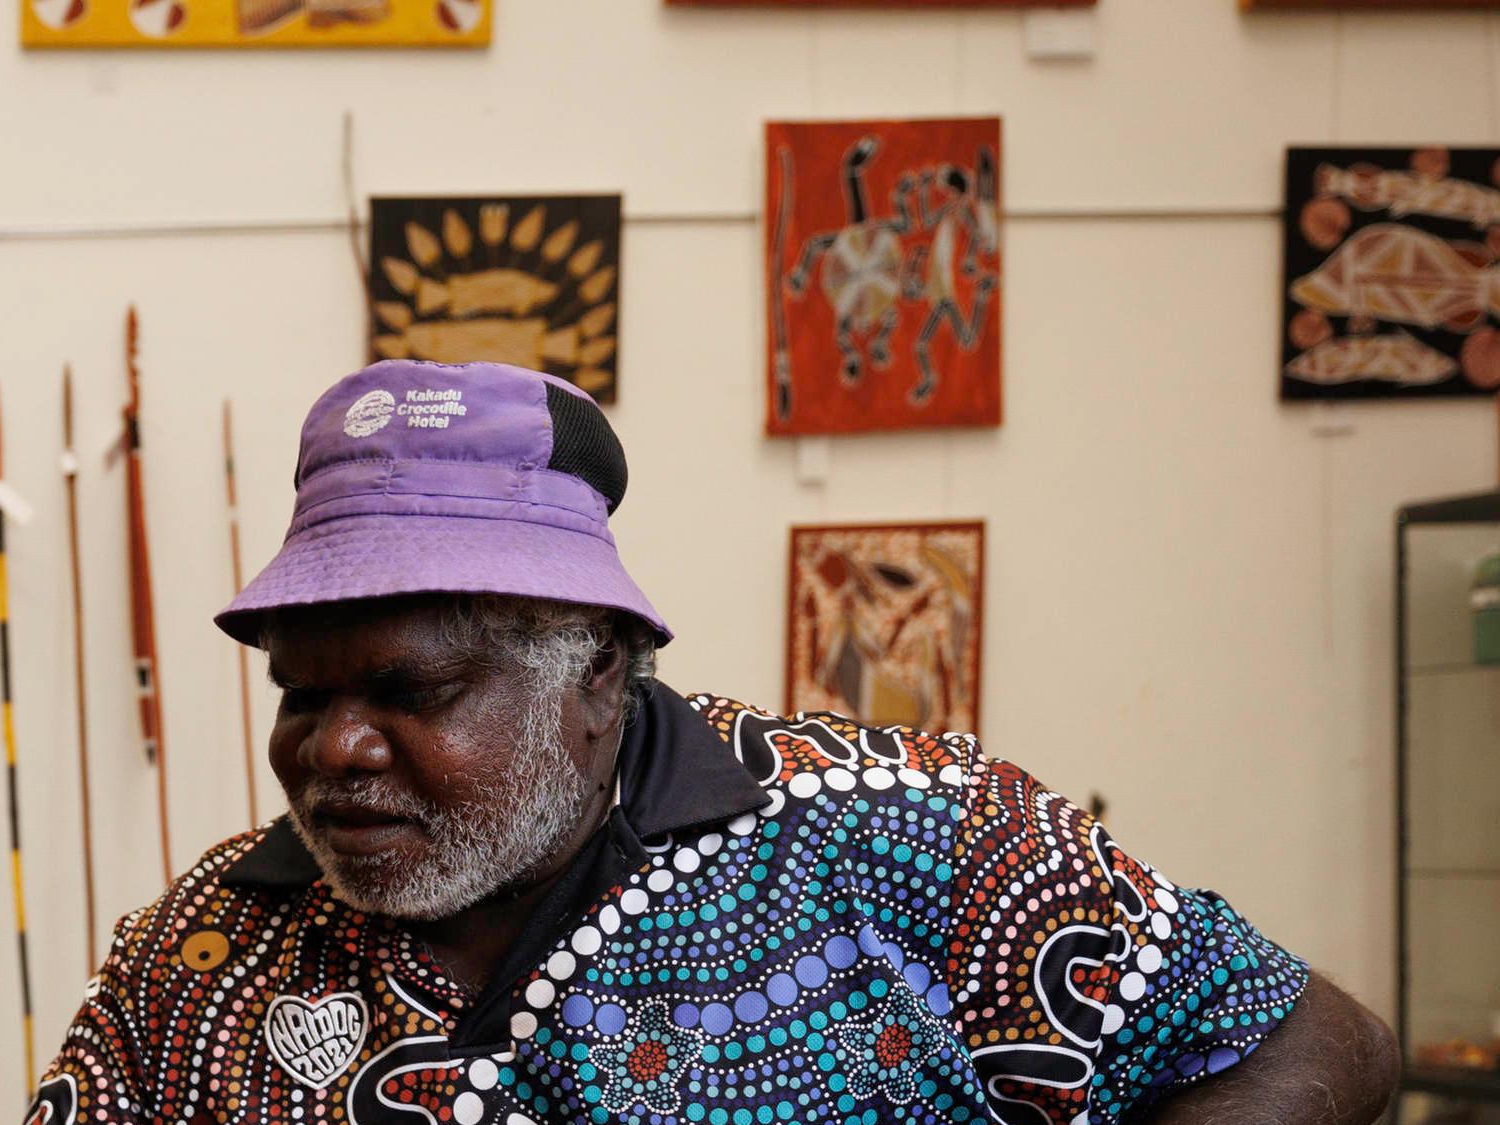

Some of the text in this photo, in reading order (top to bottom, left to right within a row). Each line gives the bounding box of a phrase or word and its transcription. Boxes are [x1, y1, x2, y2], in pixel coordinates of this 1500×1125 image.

[406, 389, 462, 401] Kakadu
[397, 402, 467, 416] Crocodile
[408, 415, 449, 428] Hotel
[273, 1001, 360, 1059] NAIDOC
[291, 1037, 354, 1081] 2021
